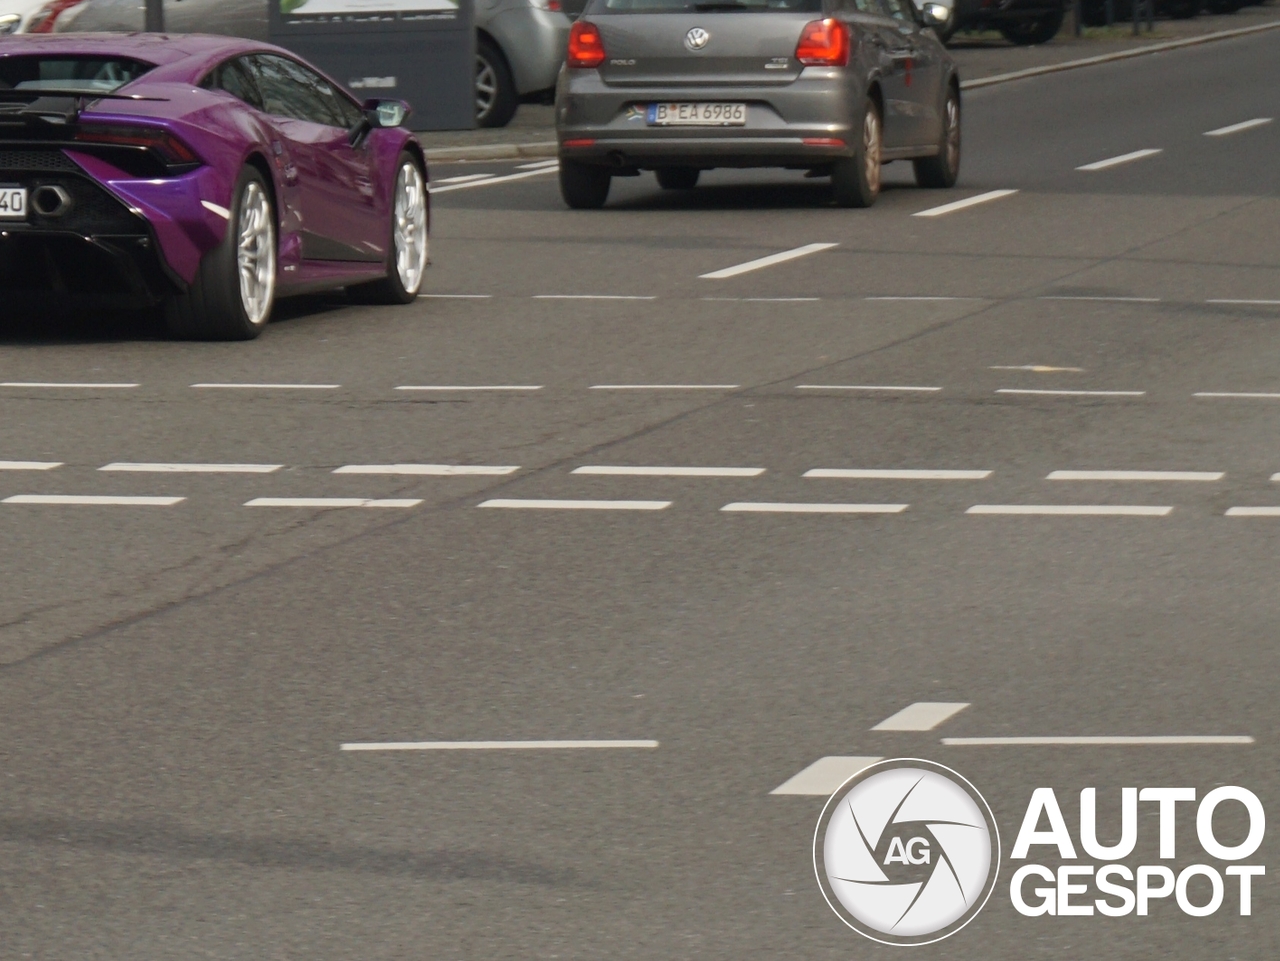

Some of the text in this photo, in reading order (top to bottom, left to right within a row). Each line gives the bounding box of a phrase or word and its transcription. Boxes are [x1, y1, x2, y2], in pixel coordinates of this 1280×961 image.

[657, 105, 742, 120] B EA 6986
